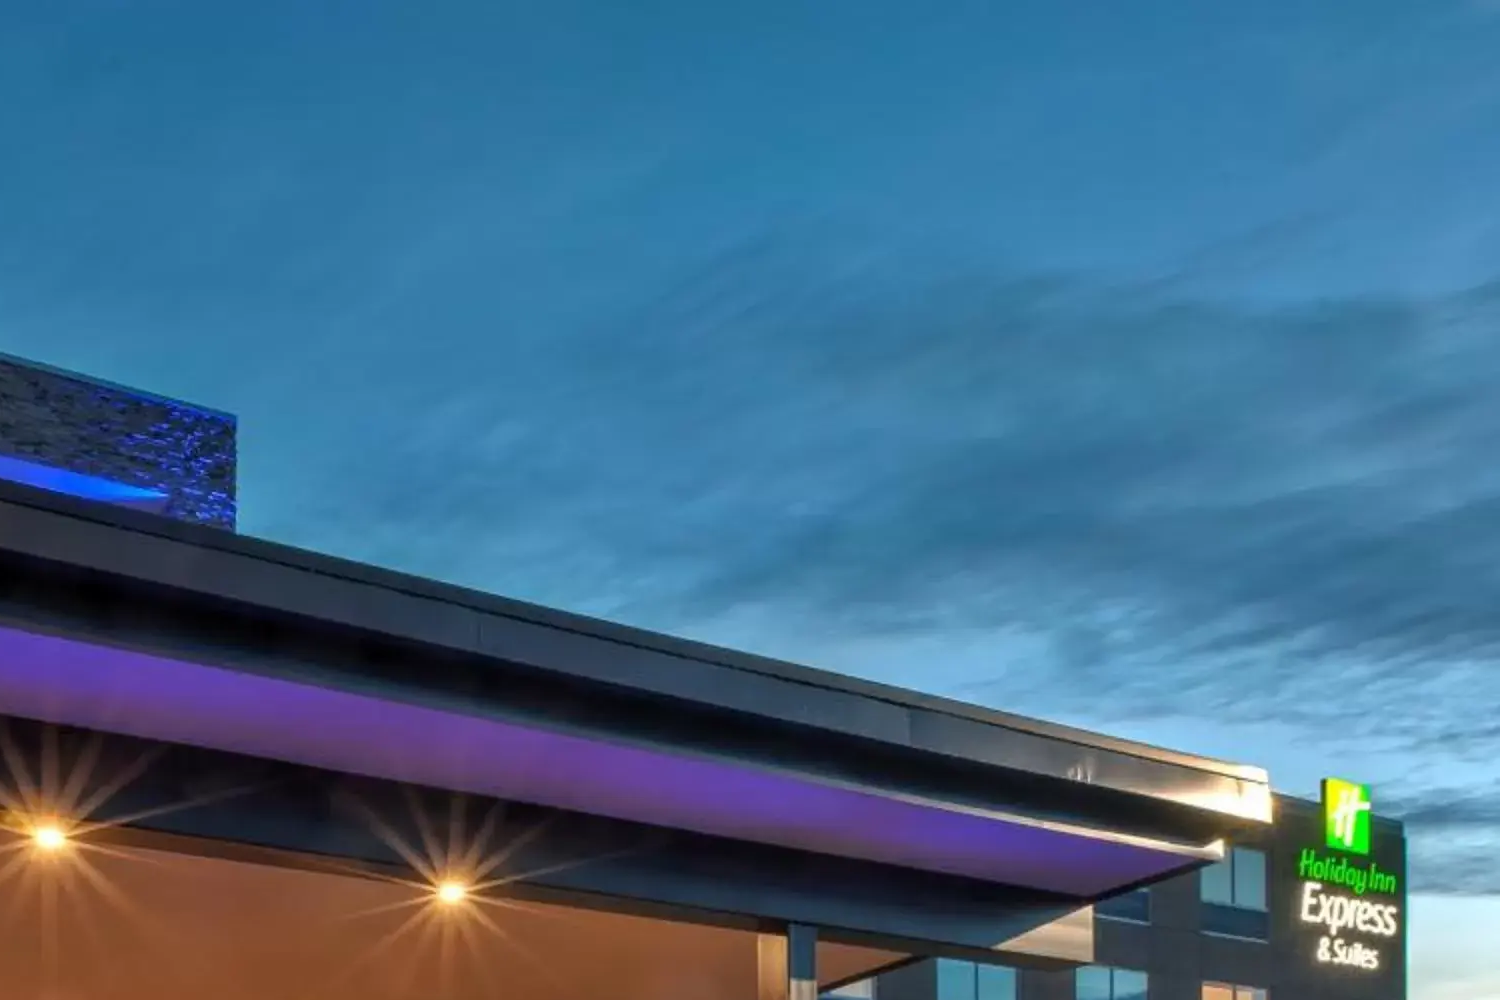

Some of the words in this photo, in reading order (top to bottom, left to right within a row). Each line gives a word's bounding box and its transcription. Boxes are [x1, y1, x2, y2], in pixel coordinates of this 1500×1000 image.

[1300, 849, 1367, 894] Holiday
[1369, 863, 1396, 893] Inn
[1301, 881, 1397, 936] Express
[1317, 937, 1332, 963] &
[1332, 938, 1379, 969] Suites
